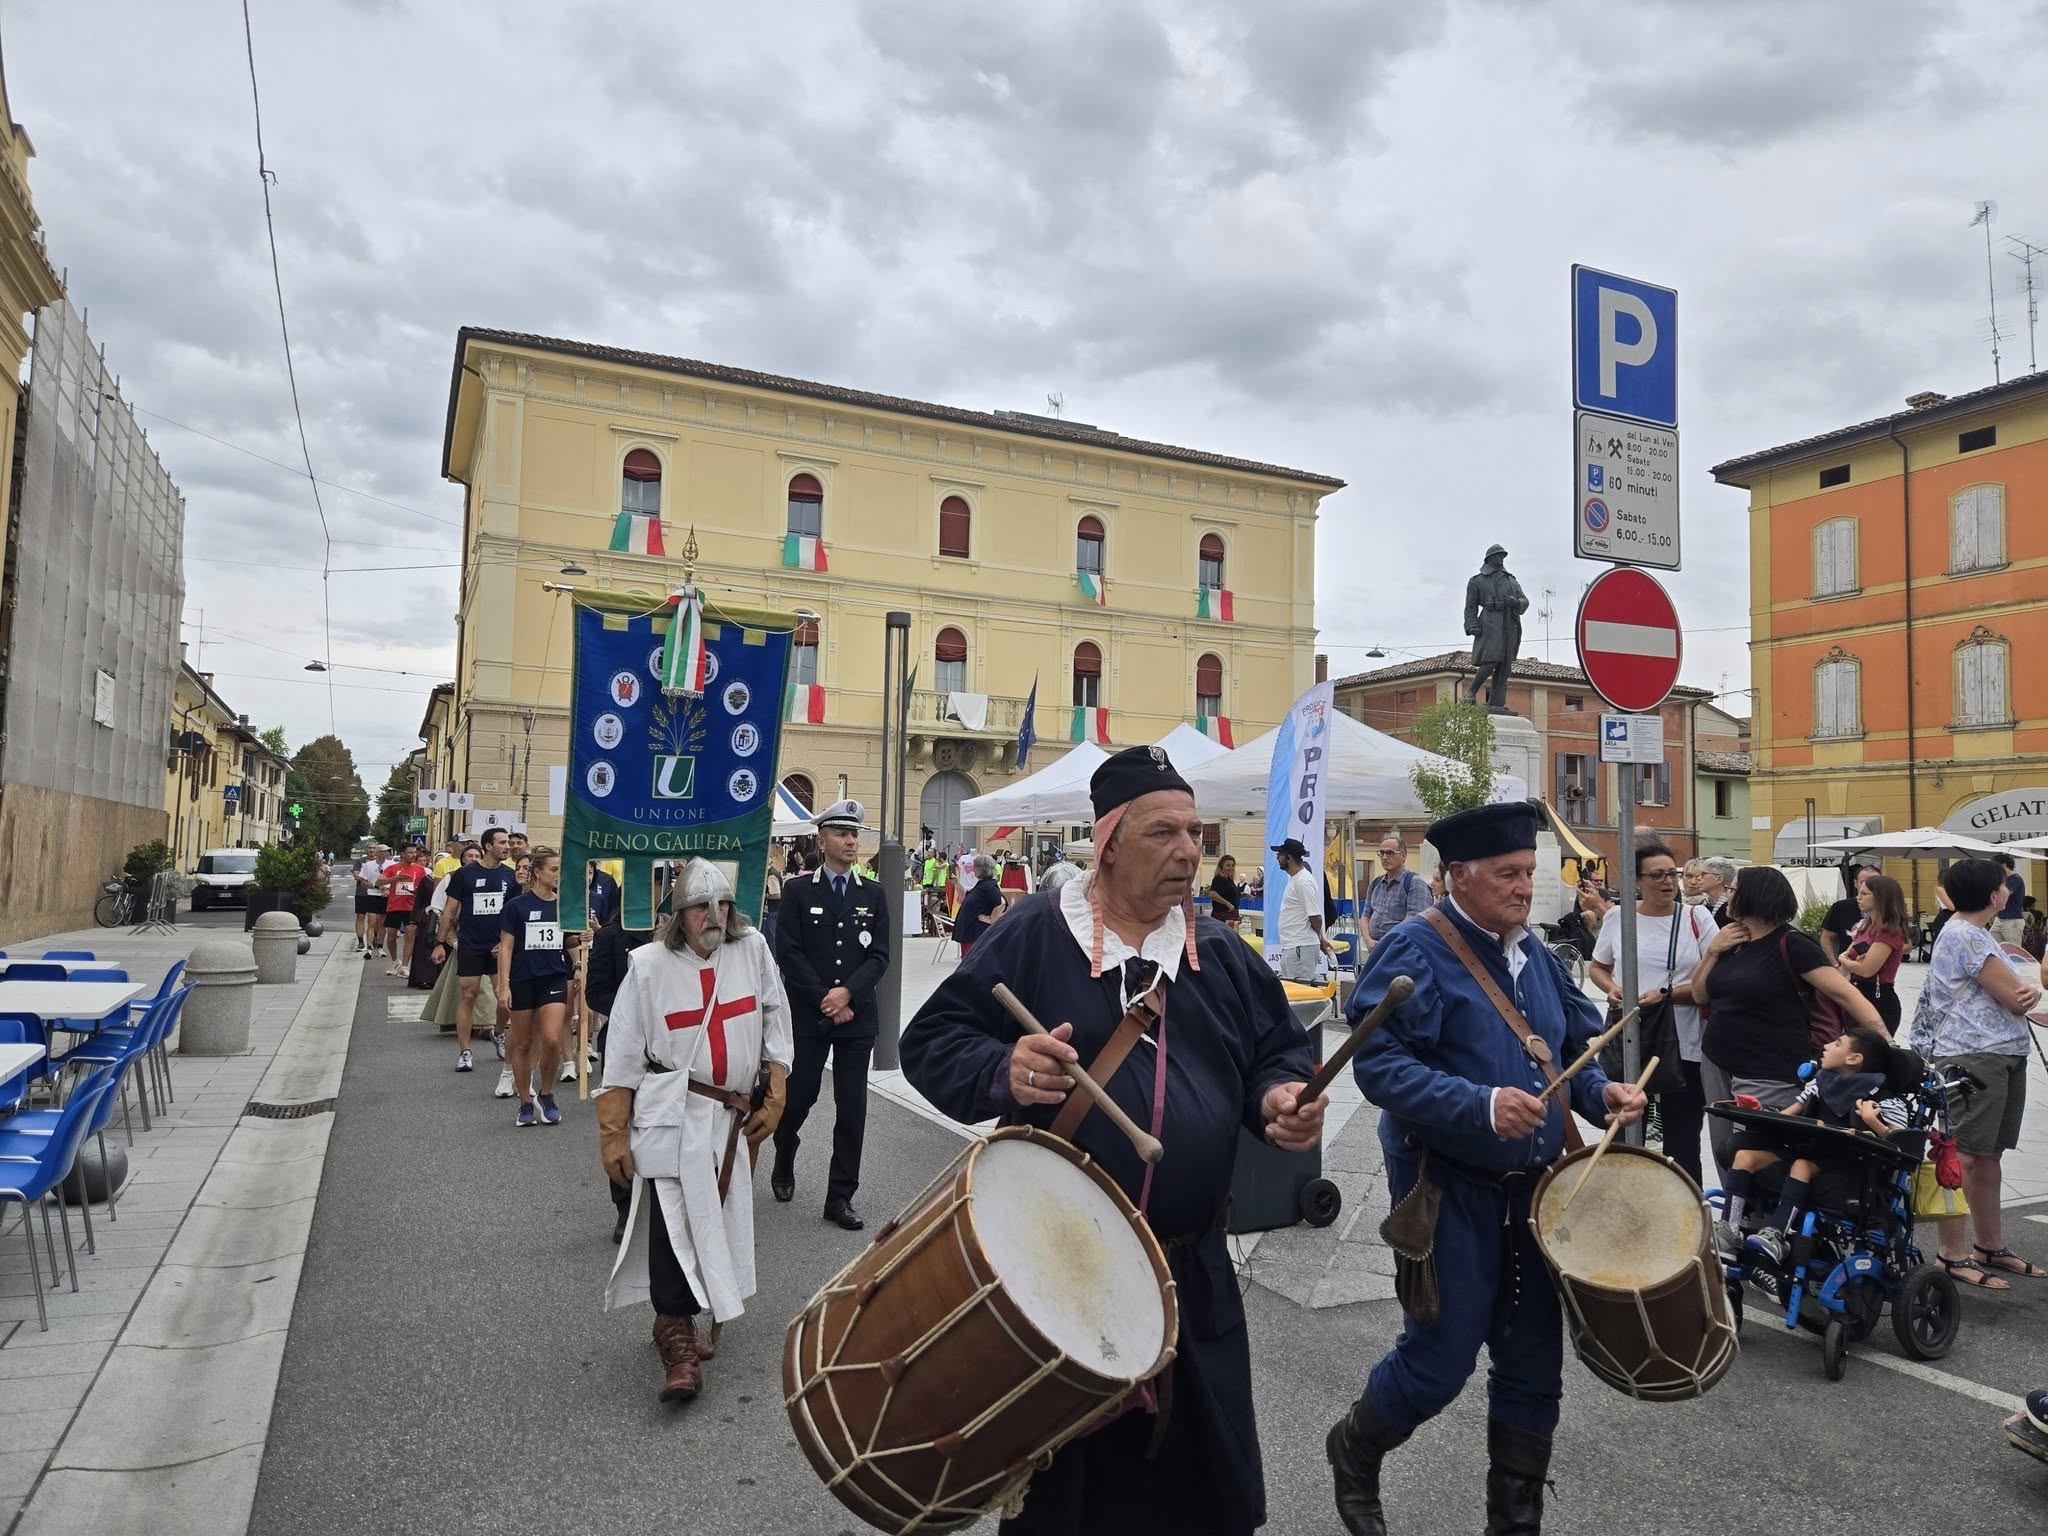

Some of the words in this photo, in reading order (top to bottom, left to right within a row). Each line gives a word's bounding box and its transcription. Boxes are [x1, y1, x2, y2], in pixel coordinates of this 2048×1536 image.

[1599, 286, 1658, 398] P
[1627, 431, 1637, 440] dal
[1639, 433, 1651, 443] Lun
[1653, 437, 1660, 445] al
[1662, 438, 1675, 448] Ven
[1627, 442, 1642, 453] 8.00
[1648, 447, 1668, 458] 20.00
[1627, 454, 1651, 466] Sabato
[1627, 466, 1645, 478] 15.00
[1652, 471, 1672, 482] 20.00
[1609, 476, 1622, 490] 60
[1627, 483, 1658, 497] minuti
[1616, 509, 1647, 524] Sabato
[1616, 528, 1638, 541] 6.00
[1647, 533, 1672, 547] 15.00
[1298, 747, 1321, 825] PRO
[634, 807, 706, 820] UNIONE
[1971, 800, 2048, 829] GELAT
[588, 831, 649, 851] RENO
[654, 831, 744, 852] GALLIERA
[483, 898, 496, 908] 14
[539, 928, 554, 942] 13
